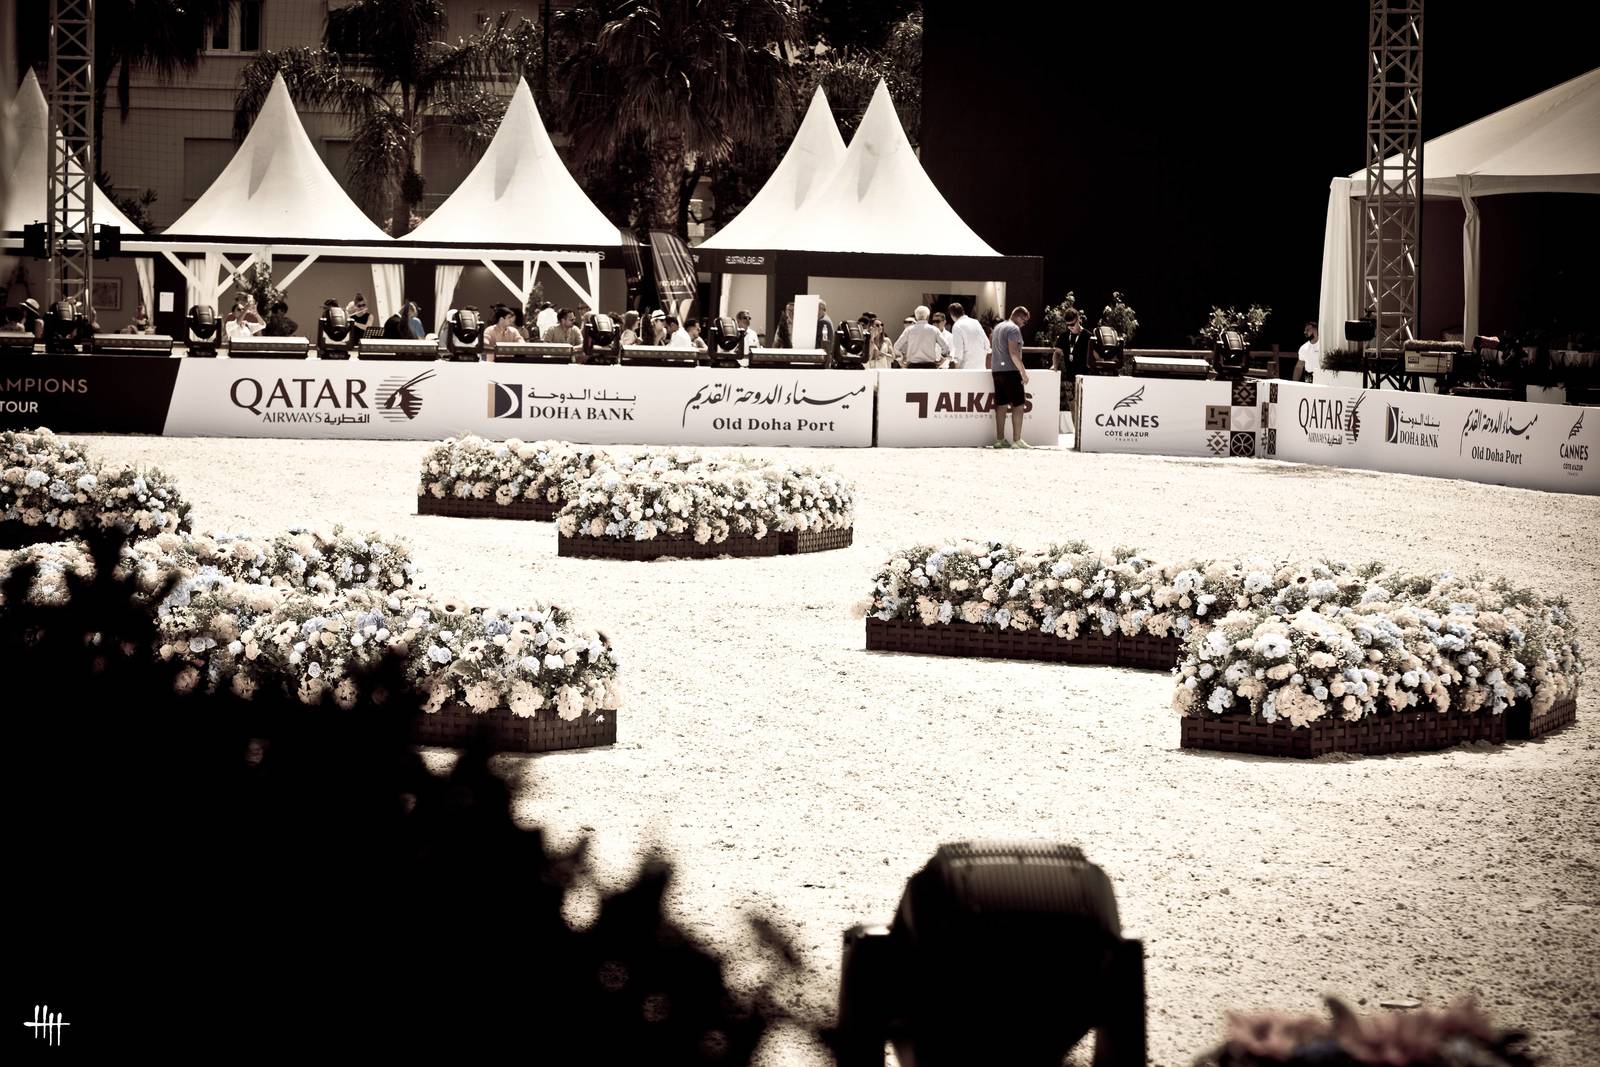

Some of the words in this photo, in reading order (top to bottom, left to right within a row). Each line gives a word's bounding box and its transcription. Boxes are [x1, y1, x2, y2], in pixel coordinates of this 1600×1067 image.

[230, 377, 369, 416] QATAR
[527, 387, 591, 404] الدوحة
[733, 383, 783, 405] الدوحة
[784, 379, 867, 410] ميناء
[934, 391, 1033, 413] ALKAS
[0, 400, 39, 413] TOUR
[529, 405, 582, 420] DOHA
[586, 407, 635, 421] BANK
[682, 383, 732, 429] القديم
[262, 412, 322, 424] AIRWAYS
[323, 412, 370, 426] القطرية
[712, 417, 742, 431] Old
[749, 417, 792, 431] Doha
[797, 418, 835, 432] Port
[1095, 413, 1160, 429] CANNES
[1298, 397, 1343, 435] QATAR
[1399, 430, 1420, 446] DOHA
[1420, 432, 1439, 449] BANK
[1471, 445, 1484, 460] Old
[1485, 447, 1504, 463] Doha
[1505, 449, 1522, 465] Port
[1559, 443, 1589, 461] CANNES
